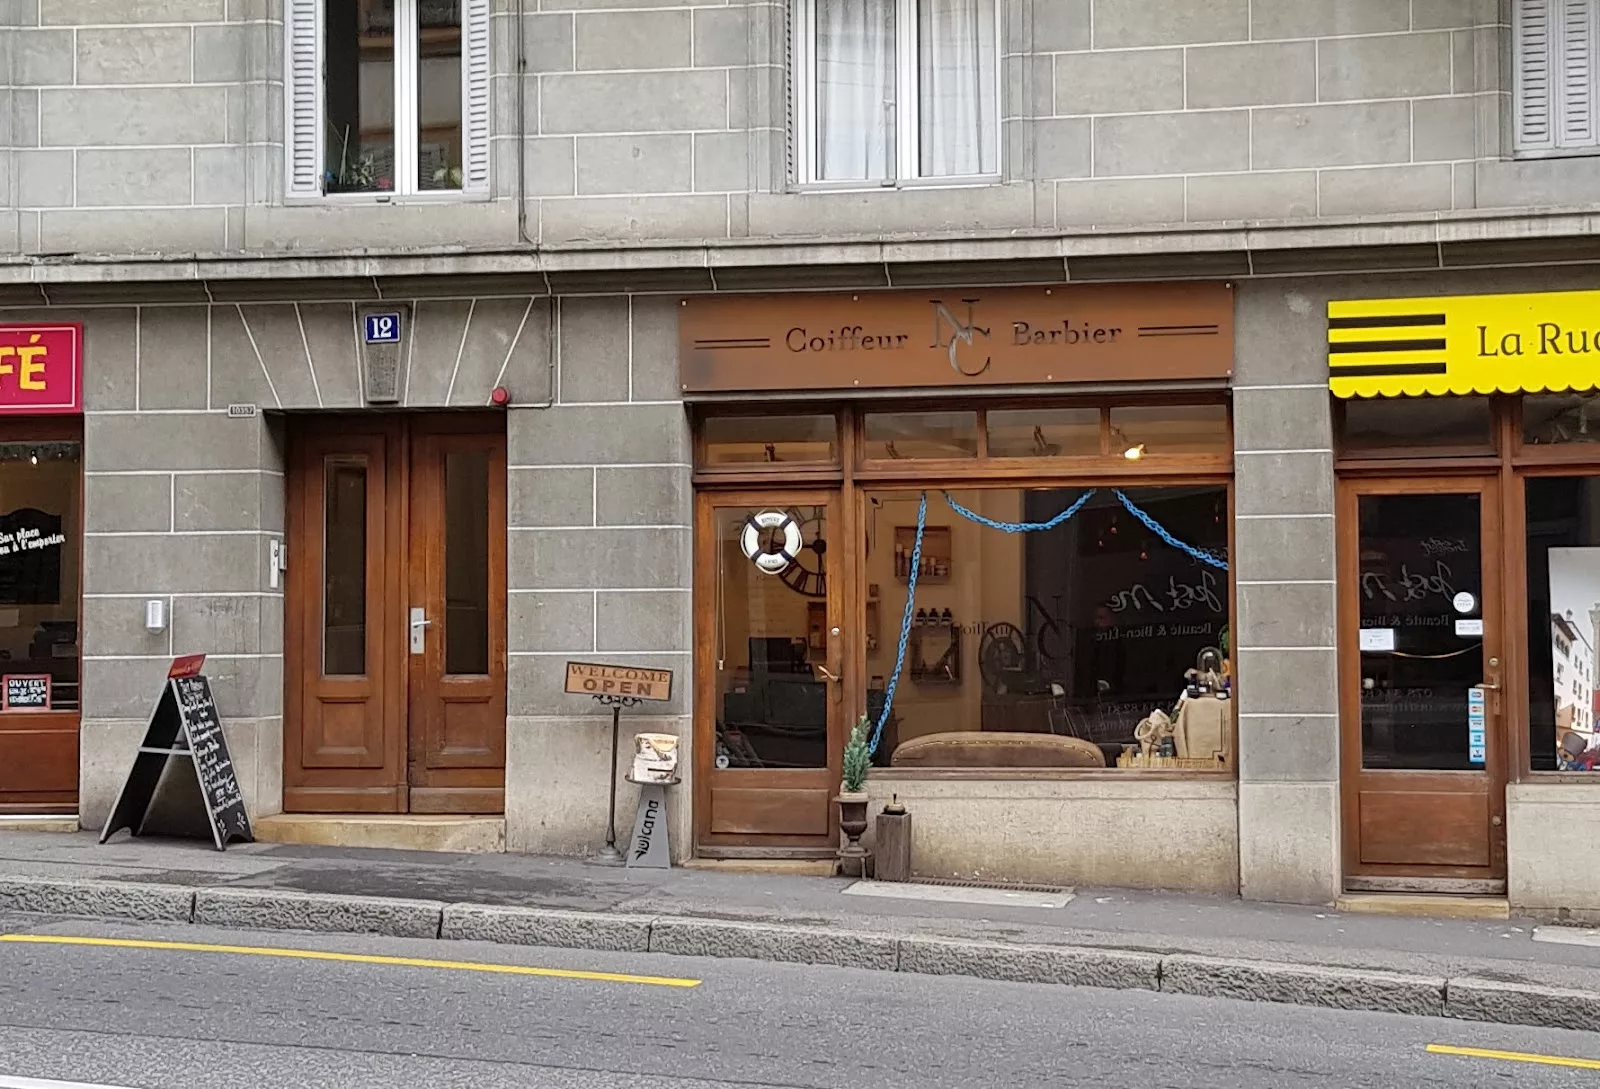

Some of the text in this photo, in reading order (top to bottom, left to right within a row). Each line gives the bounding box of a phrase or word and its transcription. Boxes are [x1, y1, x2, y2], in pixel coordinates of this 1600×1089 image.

[371, 317, 393, 339] 12
[785, 326, 909, 353] Coiffeur
[1011, 320, 1122, 347] Barbier
[1476, 325, 1524, 357] La
[16, 527, 40, 543] place
[571, 664, 669, 683] WELCOME
[583, 678, 653, 696] OPEN
